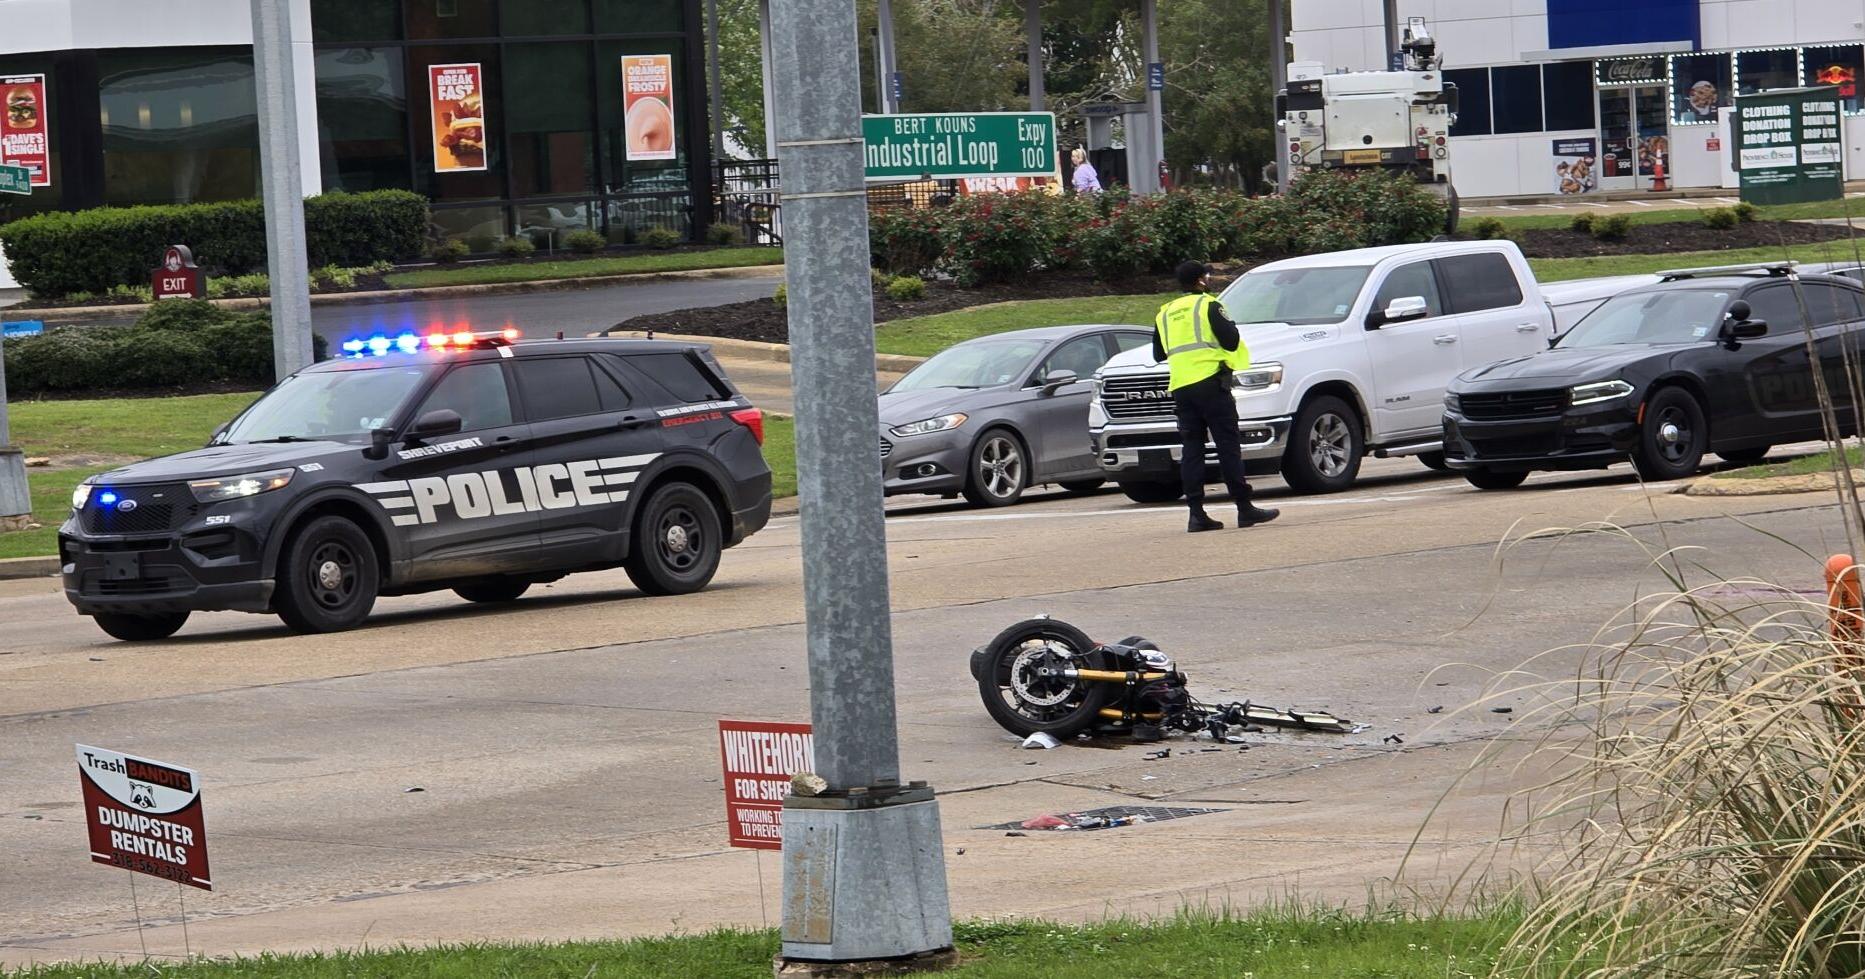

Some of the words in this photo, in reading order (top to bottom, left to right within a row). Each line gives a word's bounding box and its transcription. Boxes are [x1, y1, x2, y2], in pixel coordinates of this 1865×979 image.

[437, 74, 473, 85] BREAK
[628, 81, 666, 92] FROSTY
[438, 84, 474, 101] FAST
[1742, 105, 1791, 118] CLOTHING
[894, 117, 926, 134] BERT
[936, 117, 976, 133] KOUNS
[1018, 118, 1046, 146] Expy
[1742, 118, 1791, 131] DONATION
[1743, 133, 1770, 144] DROP
[1771, 131, 1792, 143] BOX
[10, 143, 44, 155] SINGLE
[864, 135, 953, 168] Industrial
[958, 134, 998, 170] Loop
[1021, 147, 1045, 169] 100
[163, 278, 187, 290] EXIT
[1128, 390, 1173, 400] RAM
[397, 437, 484, 460] SHREVEPORT
[407, 460, 610, 524] POLICE
[205, 515, 231, 526] 551
[84, 752, 125, 775] Trash
[127, 763, 189, 790] BANDITS
[734, 779, 759, 799] FOR
[736, 808, 773, 823] WORKING
[98, 806, 194, 846] DUMPSTER
[740, 823, 751, 836] TO
[110, 829, 187, 866] RENTALS
